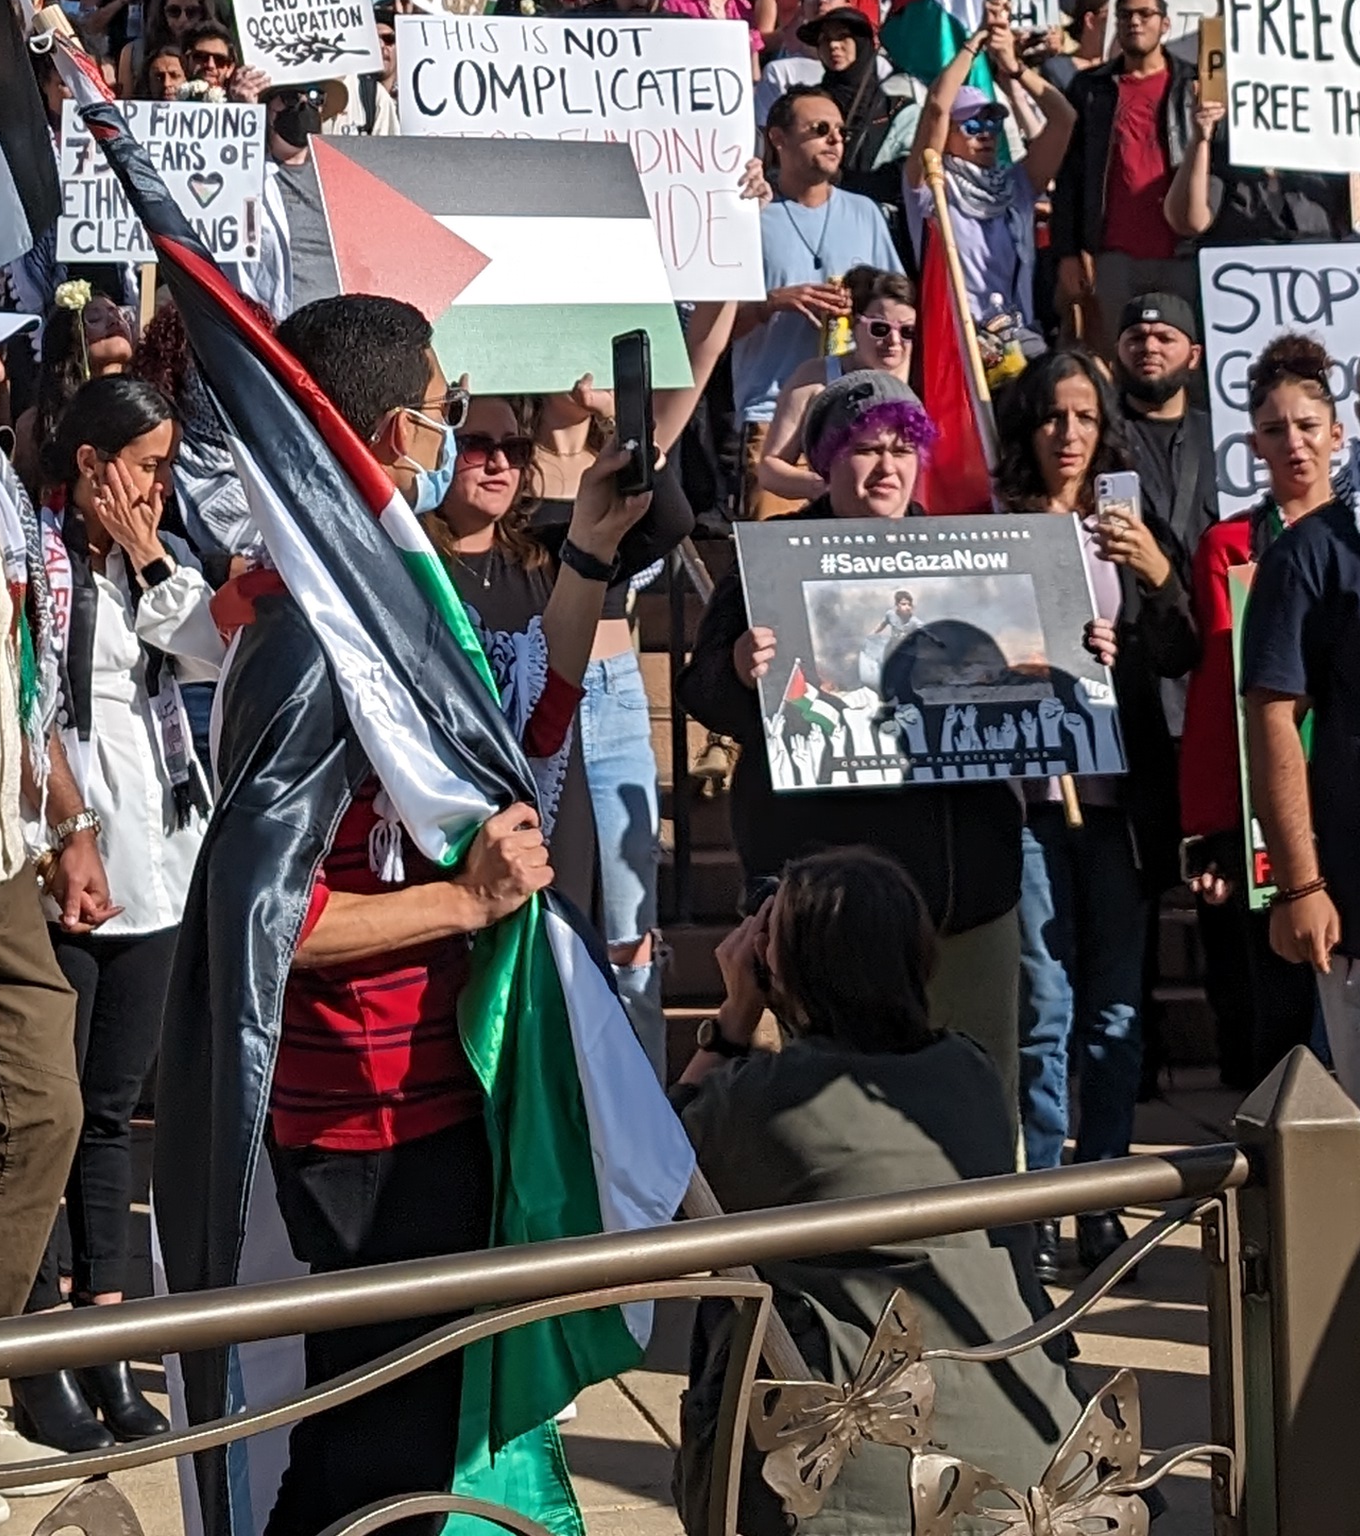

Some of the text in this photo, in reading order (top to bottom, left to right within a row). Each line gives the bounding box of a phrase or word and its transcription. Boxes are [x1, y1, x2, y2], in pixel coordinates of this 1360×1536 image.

[247, 5, 363, 40] OCCUPATION
[403, 20, 652, 60] THIS IS NOT
[412, 57, 744, 117] COMPLICATED
[150, 104, 257, 139] FUNDING
[1232, 80, 1310, 132] FREE
[142, 142, 205, 170] EARS
[220, 142, 260, 170] OF
[62, 179, 129, 218] ETHN
[1212, 262, 1360, 334] STOP
[788, 530, 1031, 545] WE STAND WITH PALESTINE
[820, 549, 1008, 574] #SaveGazaNow
[841, 756, 916, 767] COLORADO
